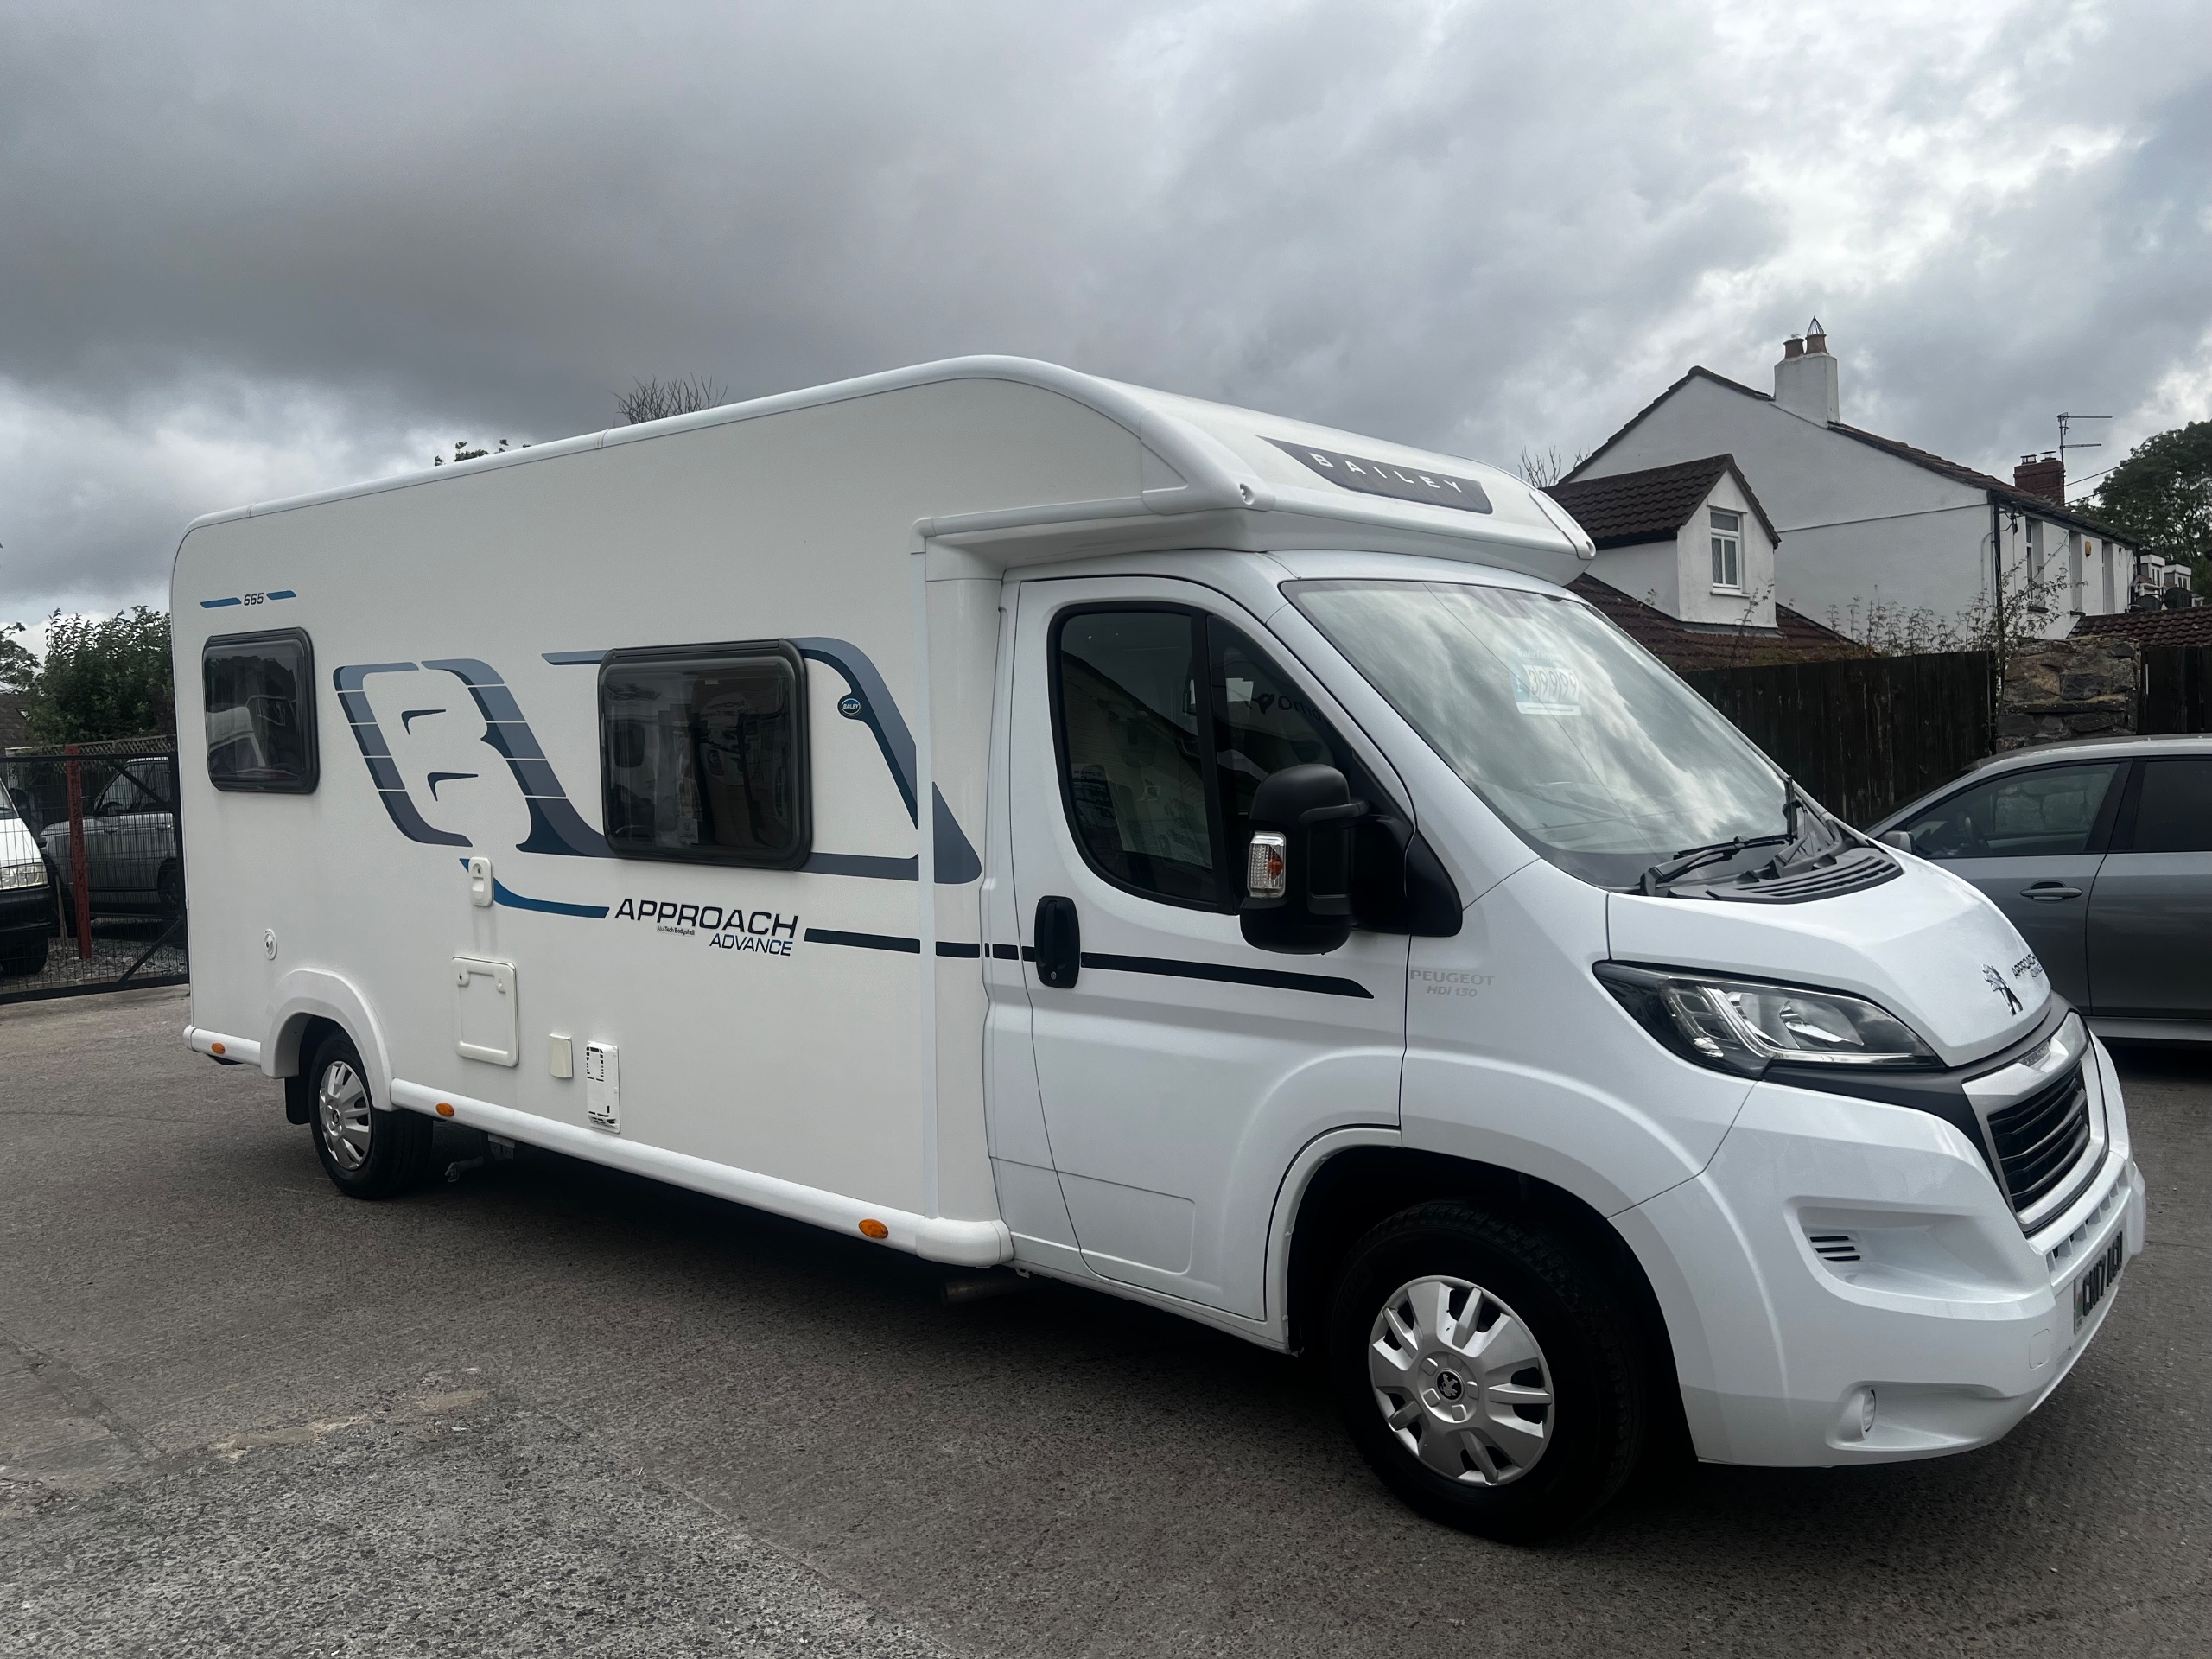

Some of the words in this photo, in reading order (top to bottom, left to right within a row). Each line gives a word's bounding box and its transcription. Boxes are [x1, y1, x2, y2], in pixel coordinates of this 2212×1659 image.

[1308, 452, 1463, 493] BAILEY
[244, 592, 264, 606] 665
[614, 898, 799, 938] APPROACH
[709, 933, 793, 957] ADVANCE
[1410, 969, 1496, 986] PEUGEOT
[1456, 988, 1478, 998] 130
